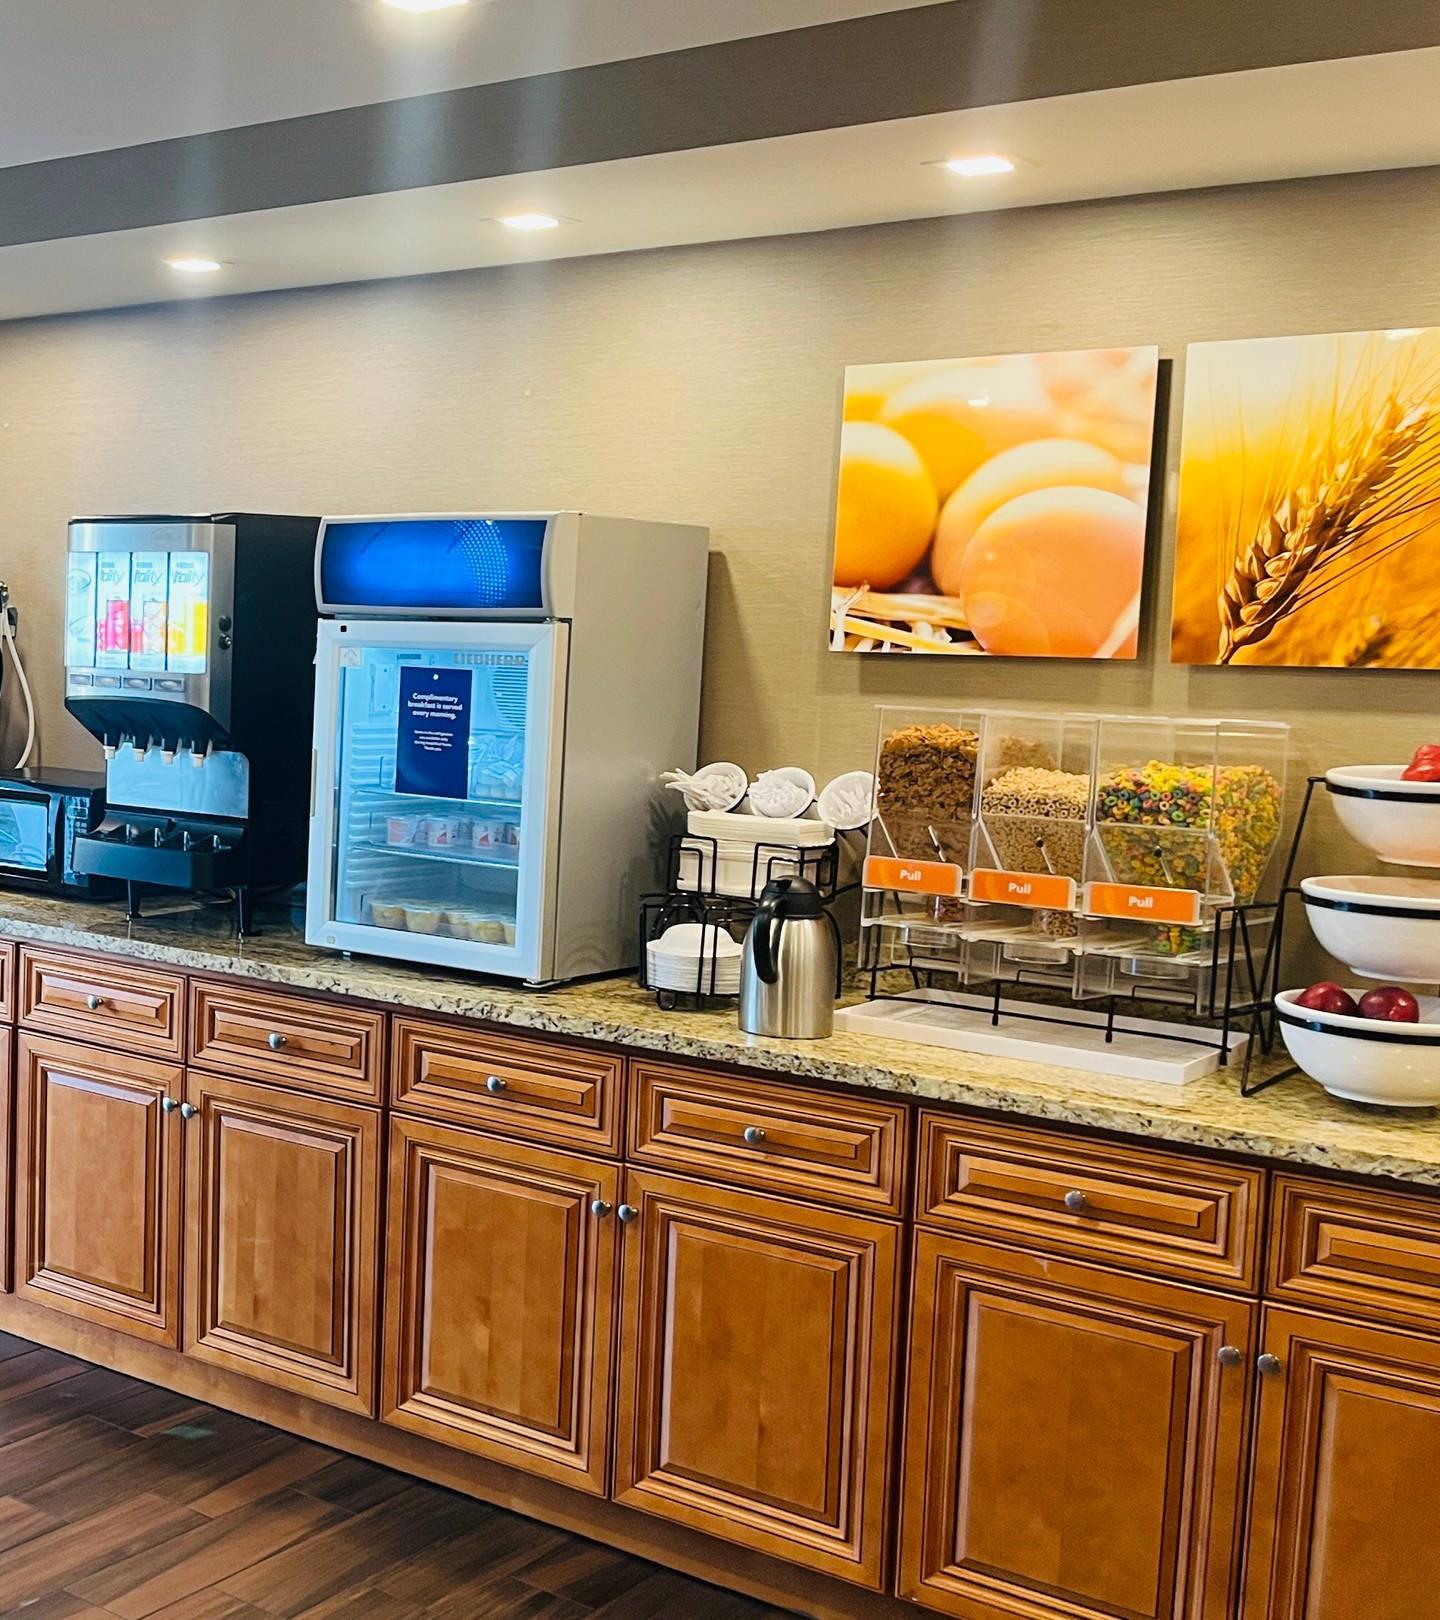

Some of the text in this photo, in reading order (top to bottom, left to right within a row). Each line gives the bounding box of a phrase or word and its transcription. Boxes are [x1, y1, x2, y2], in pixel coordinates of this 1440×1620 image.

[412, 692, 458, 704] Complimentary
[407, 700, 436, 709] breakfast
[412, 710, 429, 718] every
[899, 869, 922, 882] Pull
[1008, 882, 1032, 895] Pull
[1128, 896, 1154, 908] Pull
